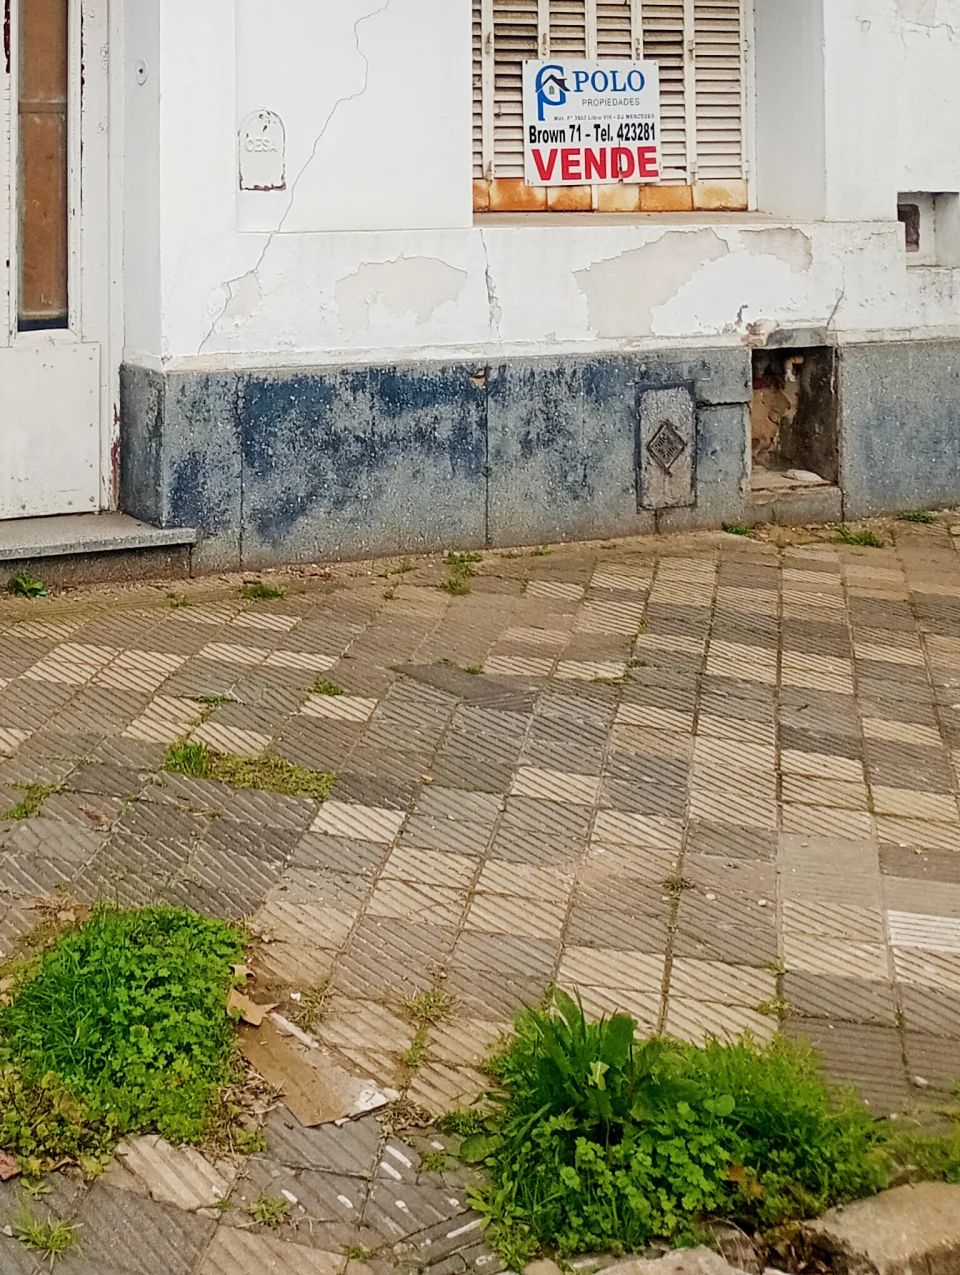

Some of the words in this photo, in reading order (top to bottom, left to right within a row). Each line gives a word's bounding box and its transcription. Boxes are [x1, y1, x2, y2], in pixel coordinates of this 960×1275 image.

[572, 69, 646, 93] POLO
[582, 98, 640, 107] PROPIEDADES
[529, 125, 566, 144] Brown
[569, 124, 582, 143] 71
[594, 124, 614, 142] Tel.
[617, 122, 656, 141] 423281
[531, 146, 659, 181] VENDE
